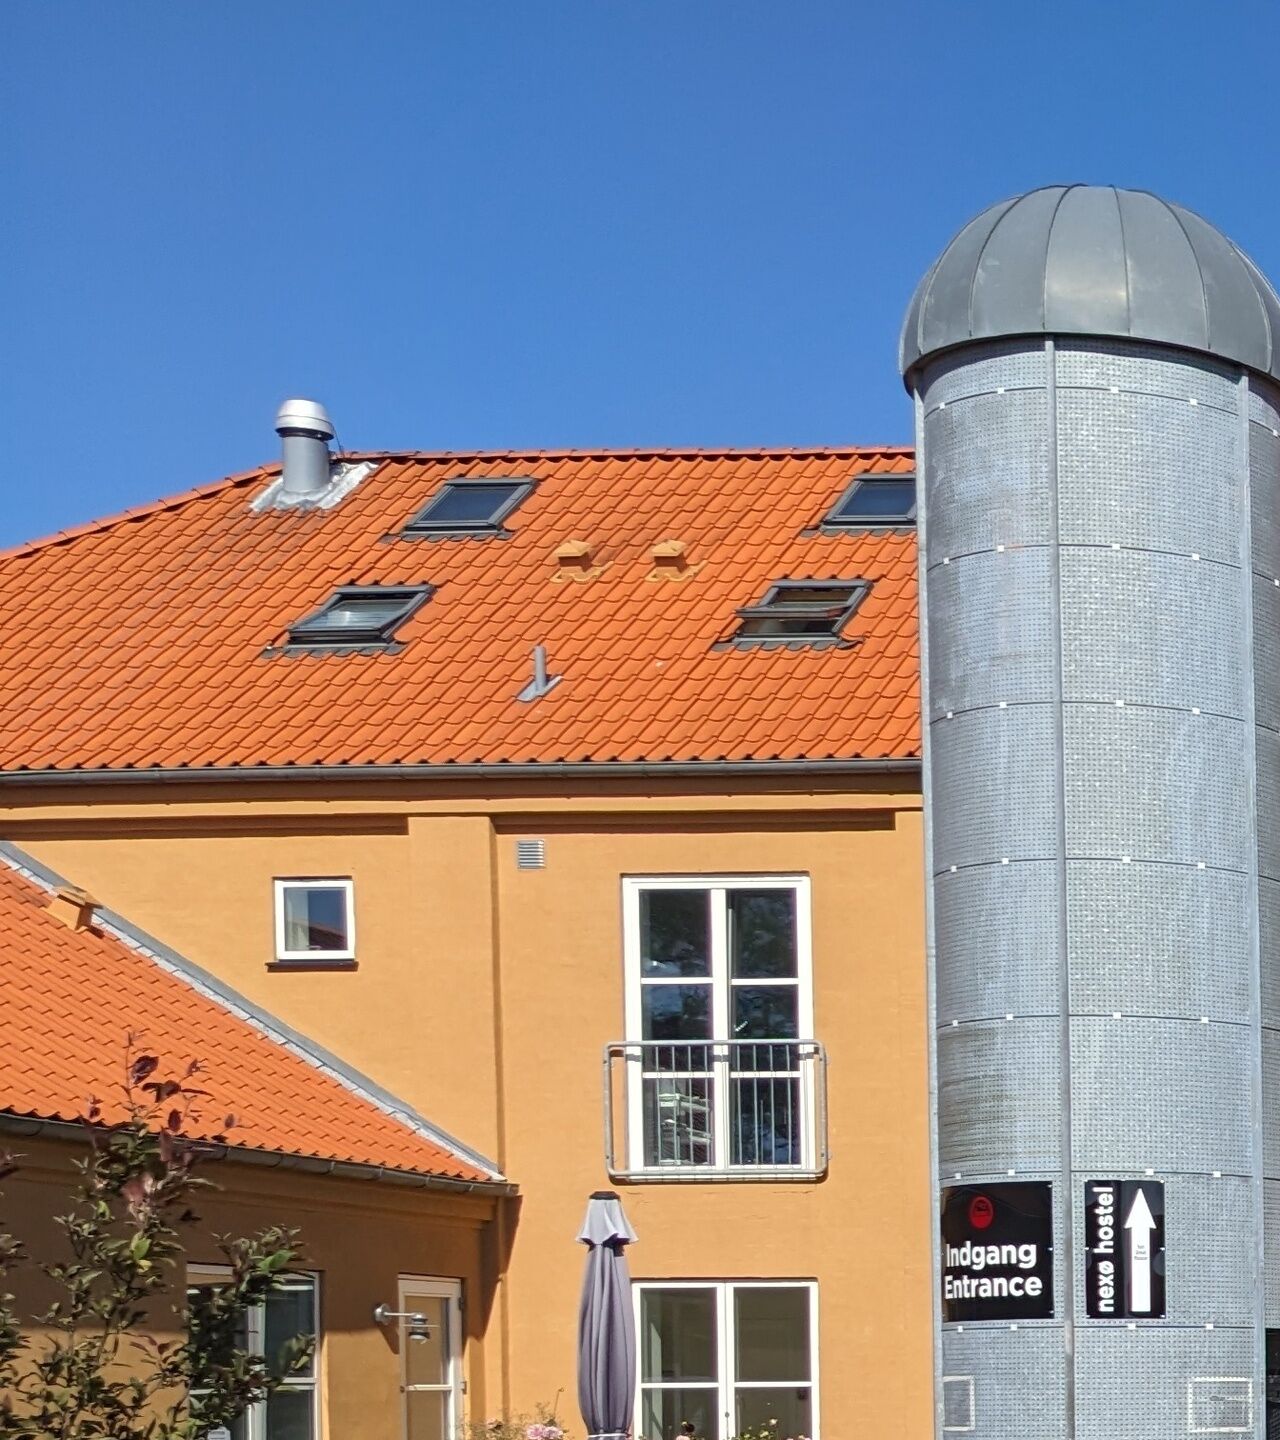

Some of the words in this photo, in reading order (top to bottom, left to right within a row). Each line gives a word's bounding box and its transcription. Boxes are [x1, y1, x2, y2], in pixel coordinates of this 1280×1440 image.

[1091, 1187, 1115, 1253] hostel
[946, 1240, 1037, 1271] Indgang
[944, 1275, 1043, 1300] Entrance
[1097, 1260, 1115, 1312] nexø
